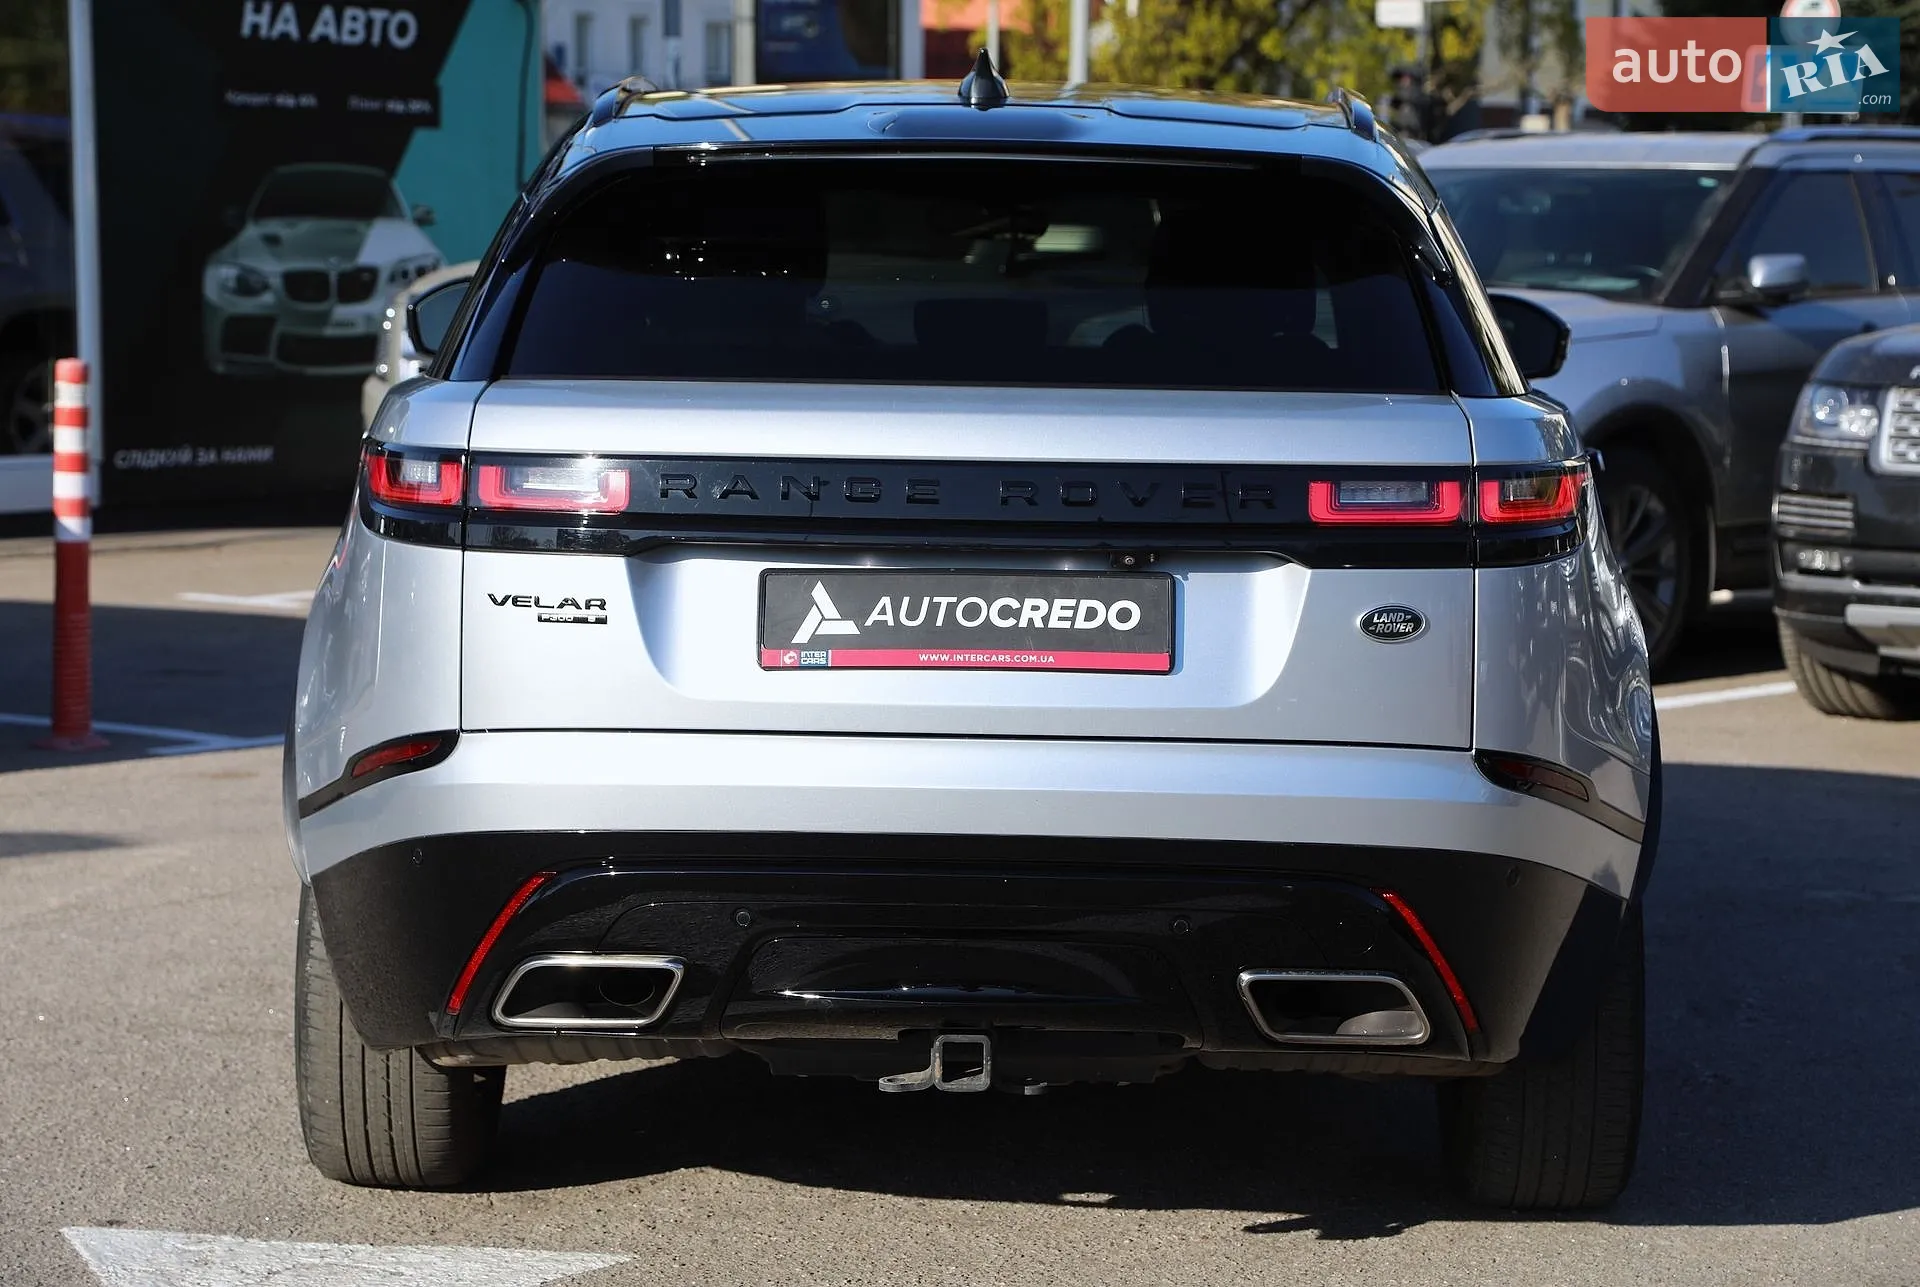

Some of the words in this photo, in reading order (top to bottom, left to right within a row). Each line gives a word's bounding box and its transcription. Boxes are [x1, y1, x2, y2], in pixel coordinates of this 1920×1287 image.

[240, 0, 299, 41] НА
[308, 5, 418, 49] АВТО
[659, 473, 940, 505] RANGE
[1000, 480, 1277, 510] ROVER
[487, 593, 607, 611] VELAR
[864, 596, 1142, 631] AUTOCREDO
[1373, 612, 1404, 623] LAND
[1376, 623, 1414, 633] ROVER
[918, 652, 1056, 664] WWW.INTERCARS.COM.UA
